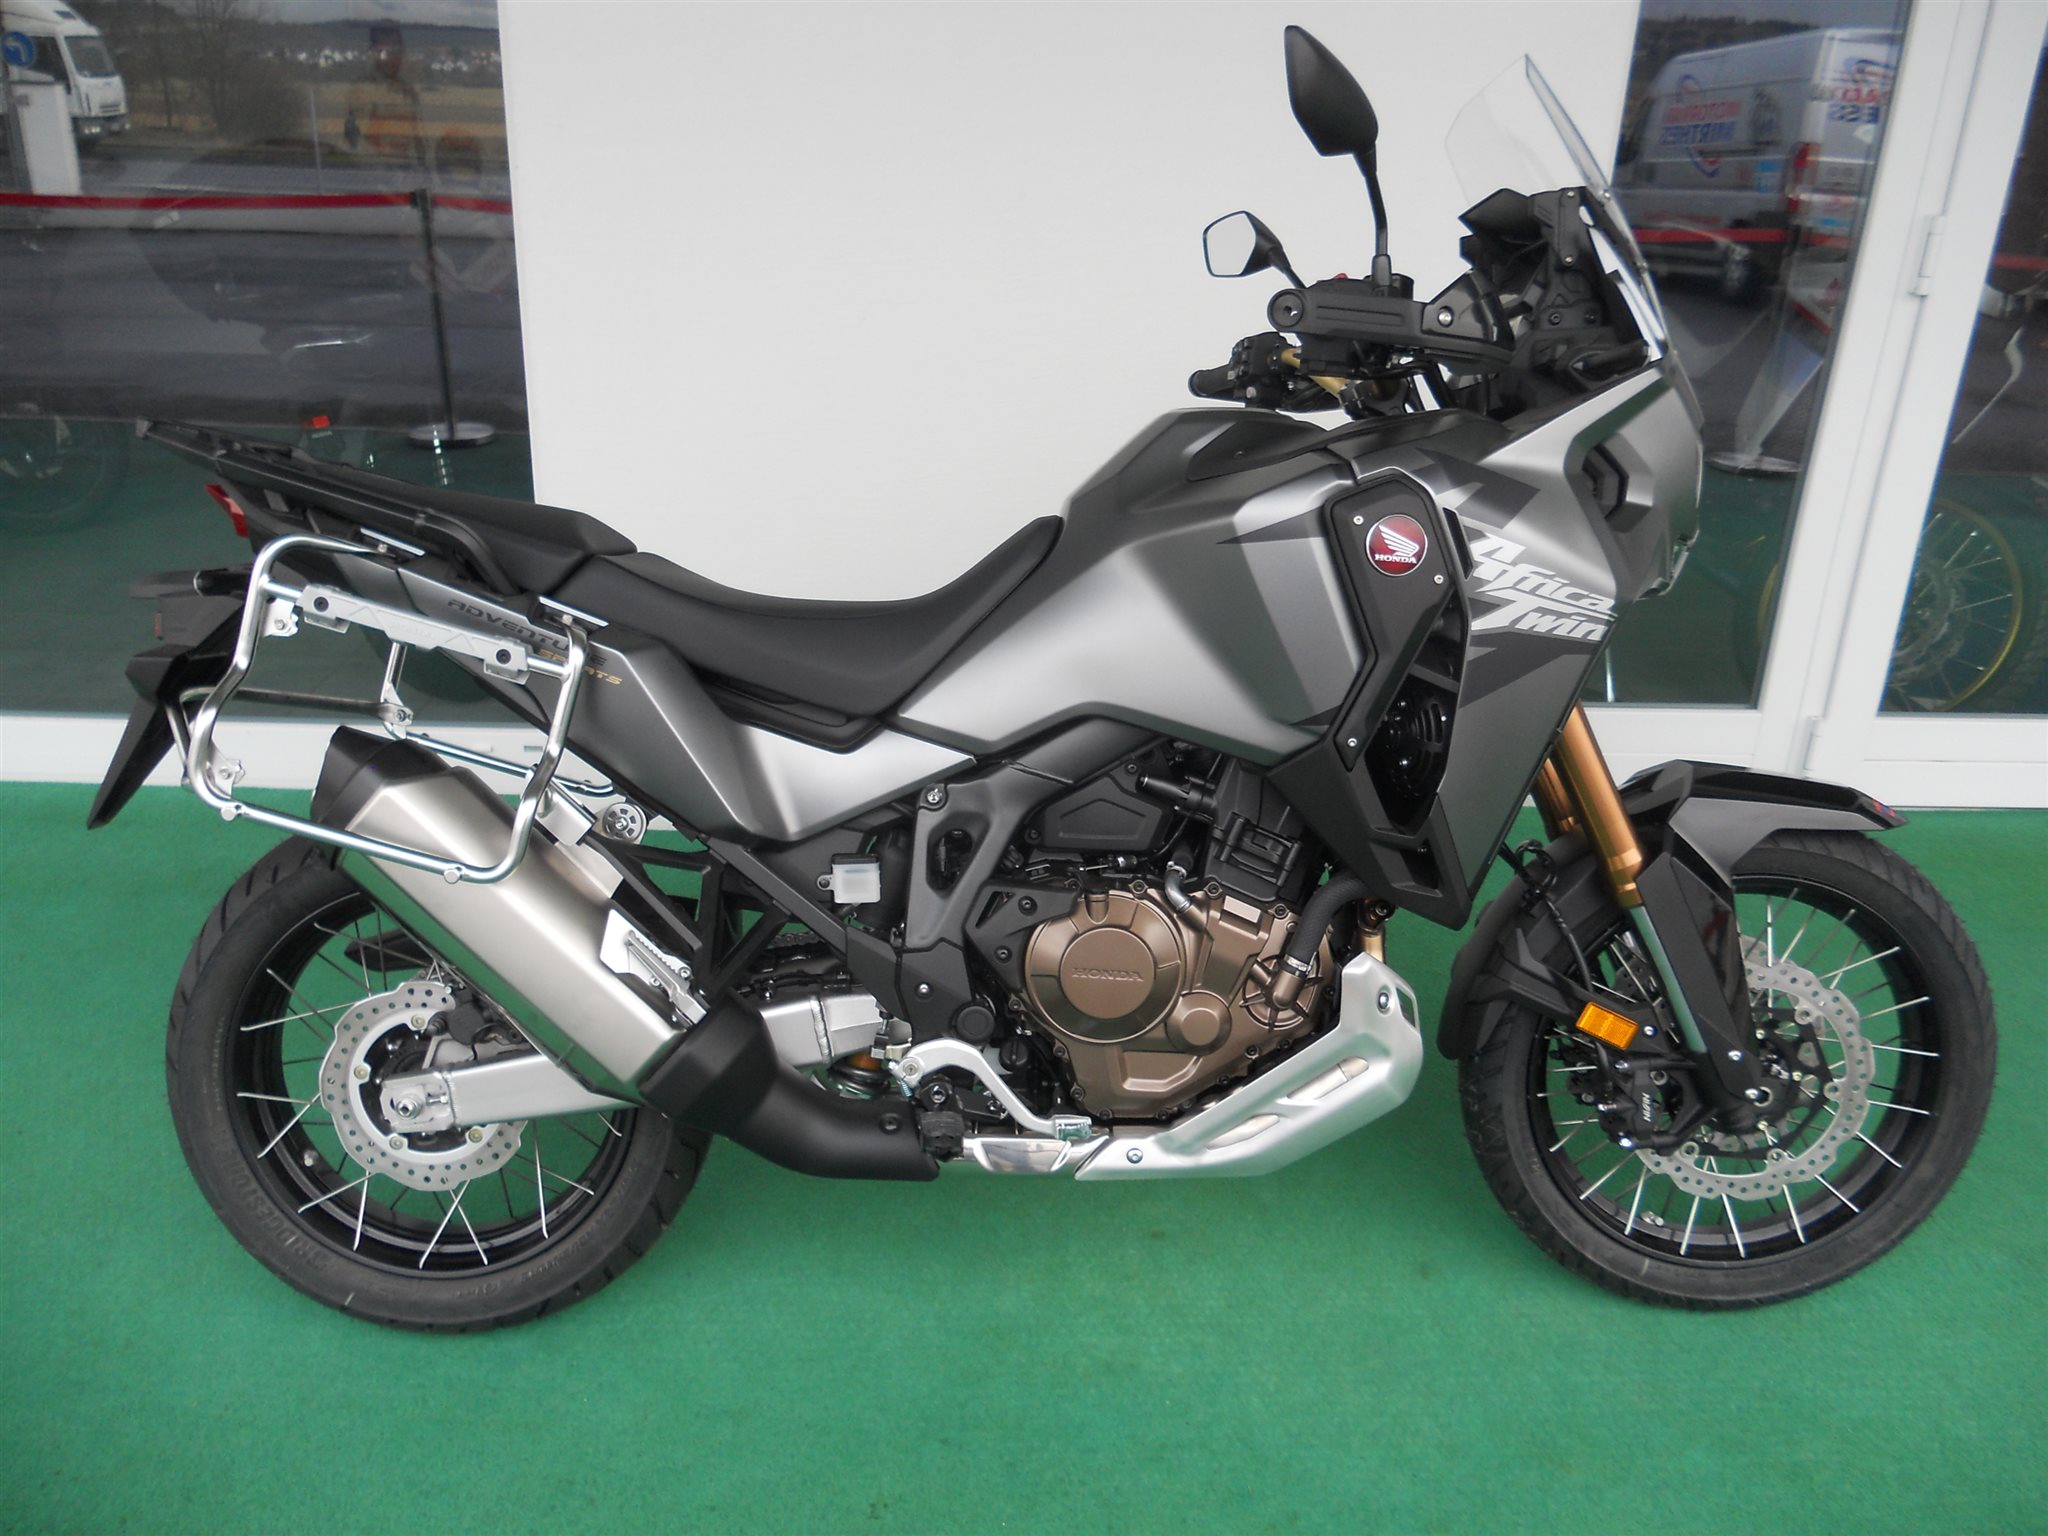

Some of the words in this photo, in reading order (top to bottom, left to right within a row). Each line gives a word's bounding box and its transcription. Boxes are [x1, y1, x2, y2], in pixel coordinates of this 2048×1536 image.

[1374, 553, 1418, 564] HONDA
[1469, 532, 1616, 613] Africa
[448, 600, 607, 667] ADVENTUE
[1471, 587, 1617, 641] Twin
[1072, 967, 1144, 982] HONDA
